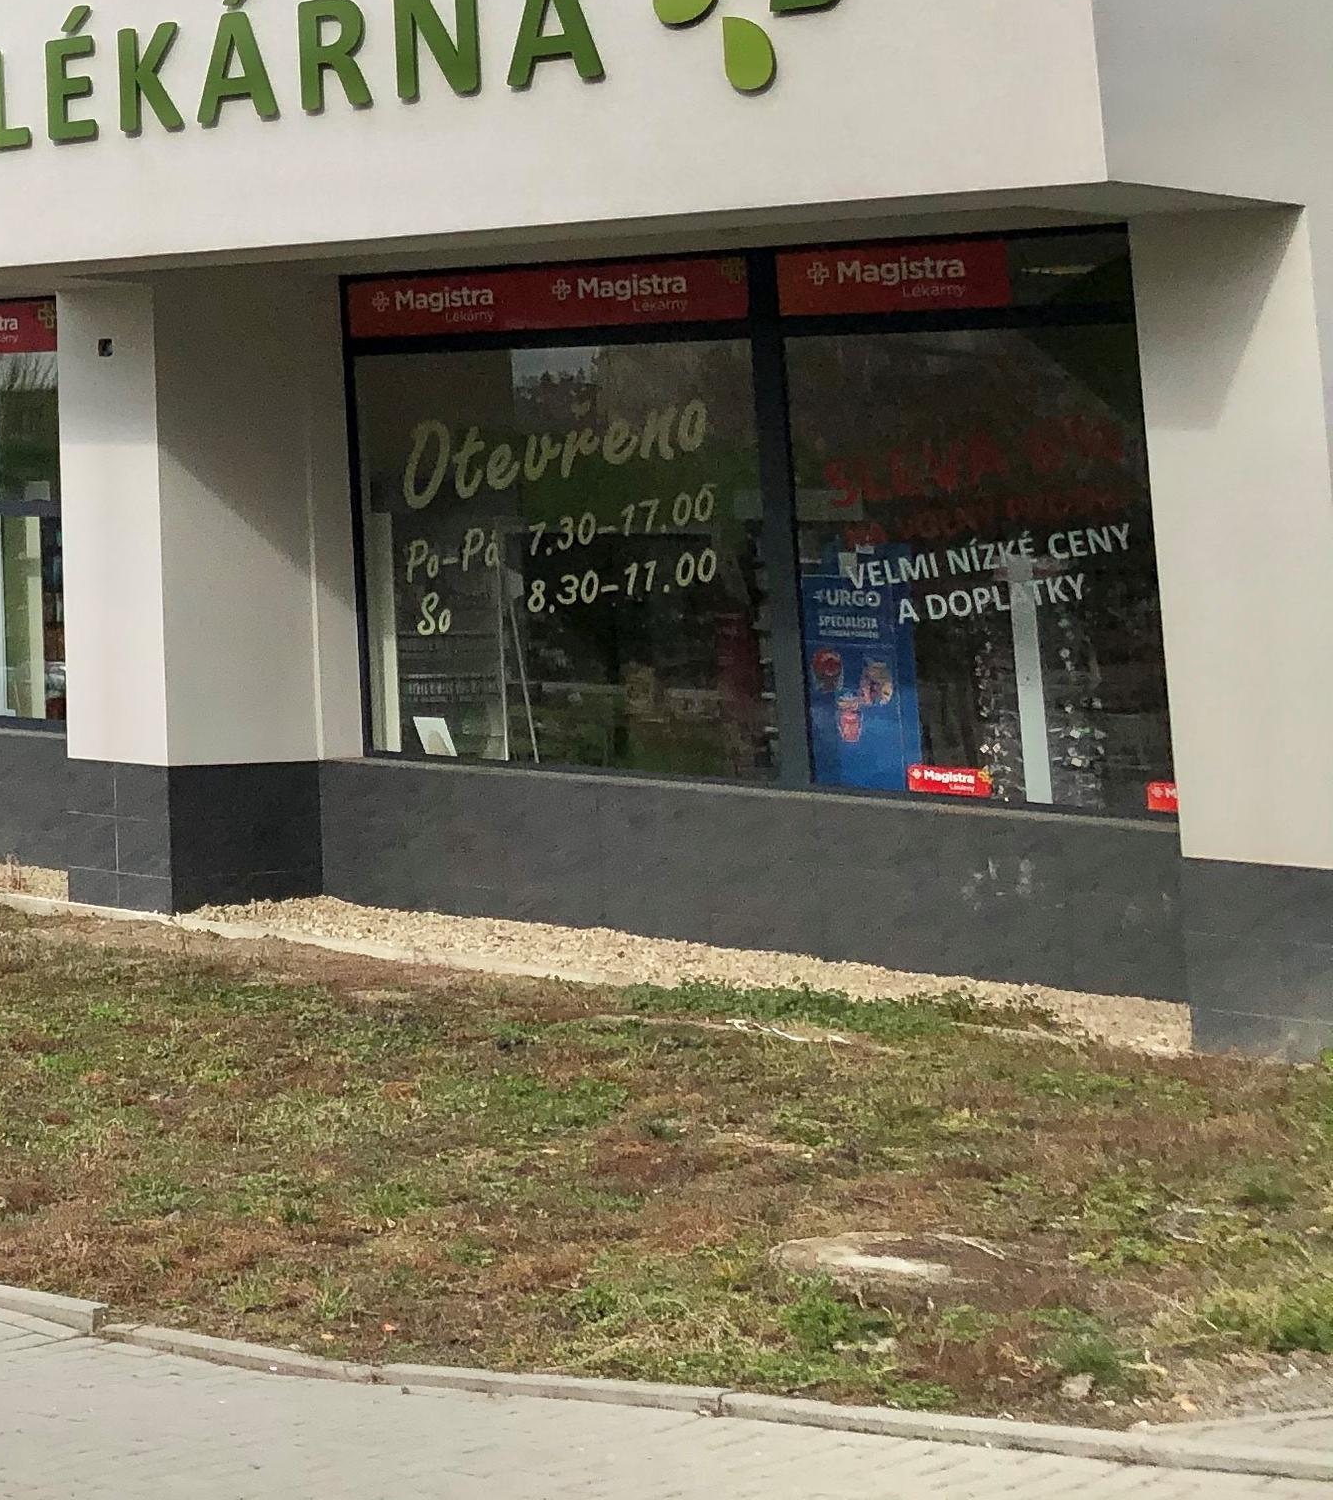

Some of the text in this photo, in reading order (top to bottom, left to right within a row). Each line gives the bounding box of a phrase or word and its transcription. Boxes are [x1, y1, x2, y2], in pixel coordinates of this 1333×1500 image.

[837, 257, 965, 285] Magistra
[395, 286, 494, 313] Magistra
[577, 274, 687, 300] Magistra
[403, 400, 708, 509] Otevřeno
[846, 523, 1130, 589] VELMI NÍZKÉ CENY
[826, 588, 881, 607] URGO
[898, 573, 1084, 624] A DOPLTKY
[417, 591, 451, 636] So
[923, 769, 975, 785] Magistra
